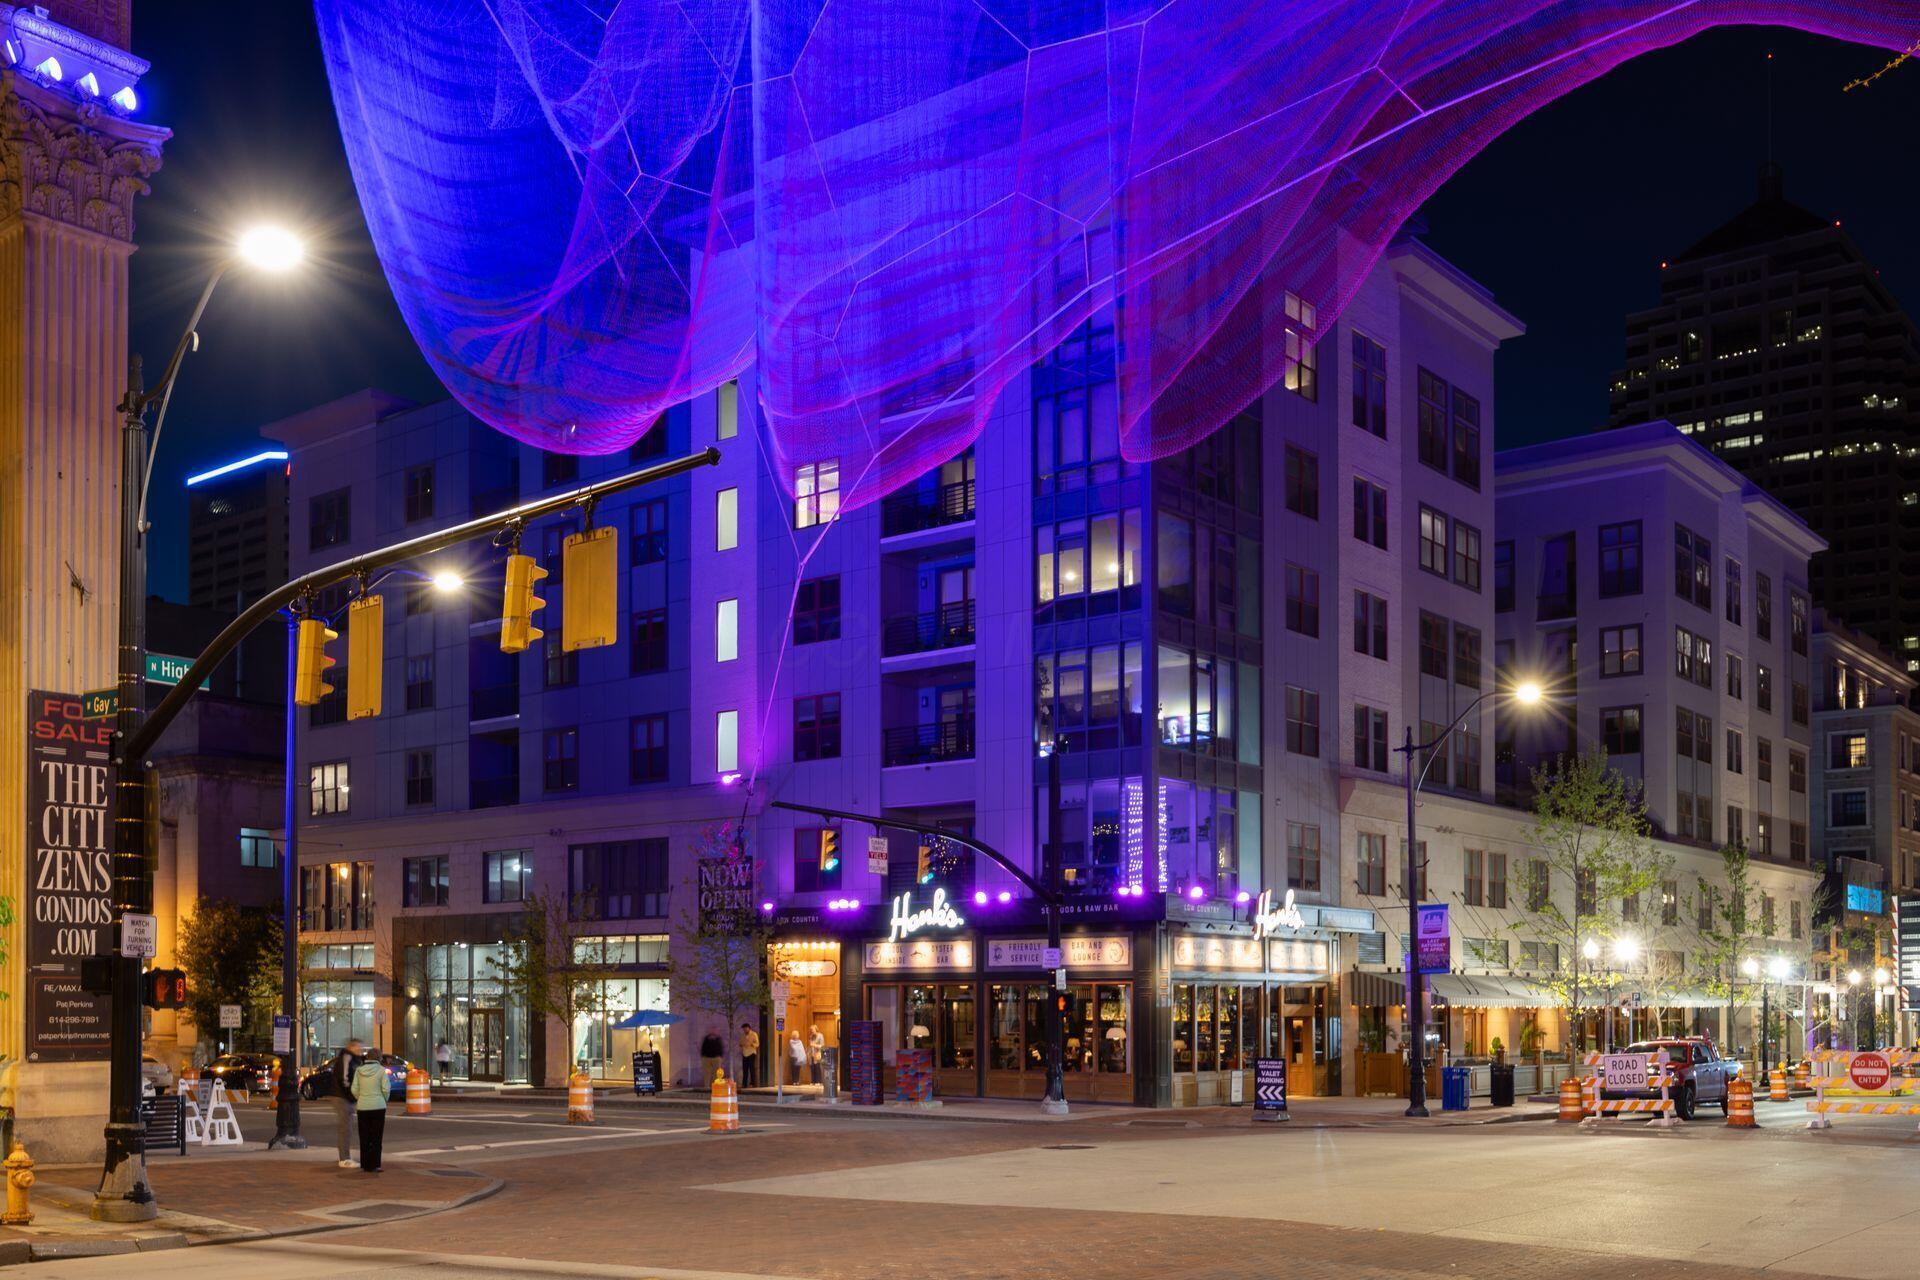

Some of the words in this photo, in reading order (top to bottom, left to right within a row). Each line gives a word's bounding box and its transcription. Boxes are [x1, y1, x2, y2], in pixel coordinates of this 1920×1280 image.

[151, 662, 157, 671] N
[93, 696, 111, 715] Gay
[34, 721, 113, 746] SALE
[41, 761, 108, 807] THE
[42, 805, 107, 850] CITI
[36, 848, 112, 893] ZENS
[701, 864, 751, 888] NOW
[35, 895, 112, 925] CONDOS
[1041, 905, 1074, 915] SEOOD
[1084, 904, 1101, 913] RAW
[1103, 903, 1118, 912] BAR
[130, 919, 150, 927] WATCH
[51, 928, 97, 956] .COM
[127, 936, 152, 944] TURNING
[931, 944, 954, 953] OYSTER
[1008, 943, 1041, 951] FRIENDLY
[1071, 941, 1085, 950] BAR
[1088, 941, 1103, 950] AND
[936, 956, 949, 964] BAR
[1010, 954, 1040, 962] SERVICE
[1073, 953, 1101, 961] LOUNGE
[44, 983, 78, 995] RE/MAX
[56, 1000, 69, 1008] Pat
[69, 1000, 94, 1008] Perkins
[1611, 1060, 1638, 1070] ROAD
[1607, 1074, 1644, 1085] CLOSED
